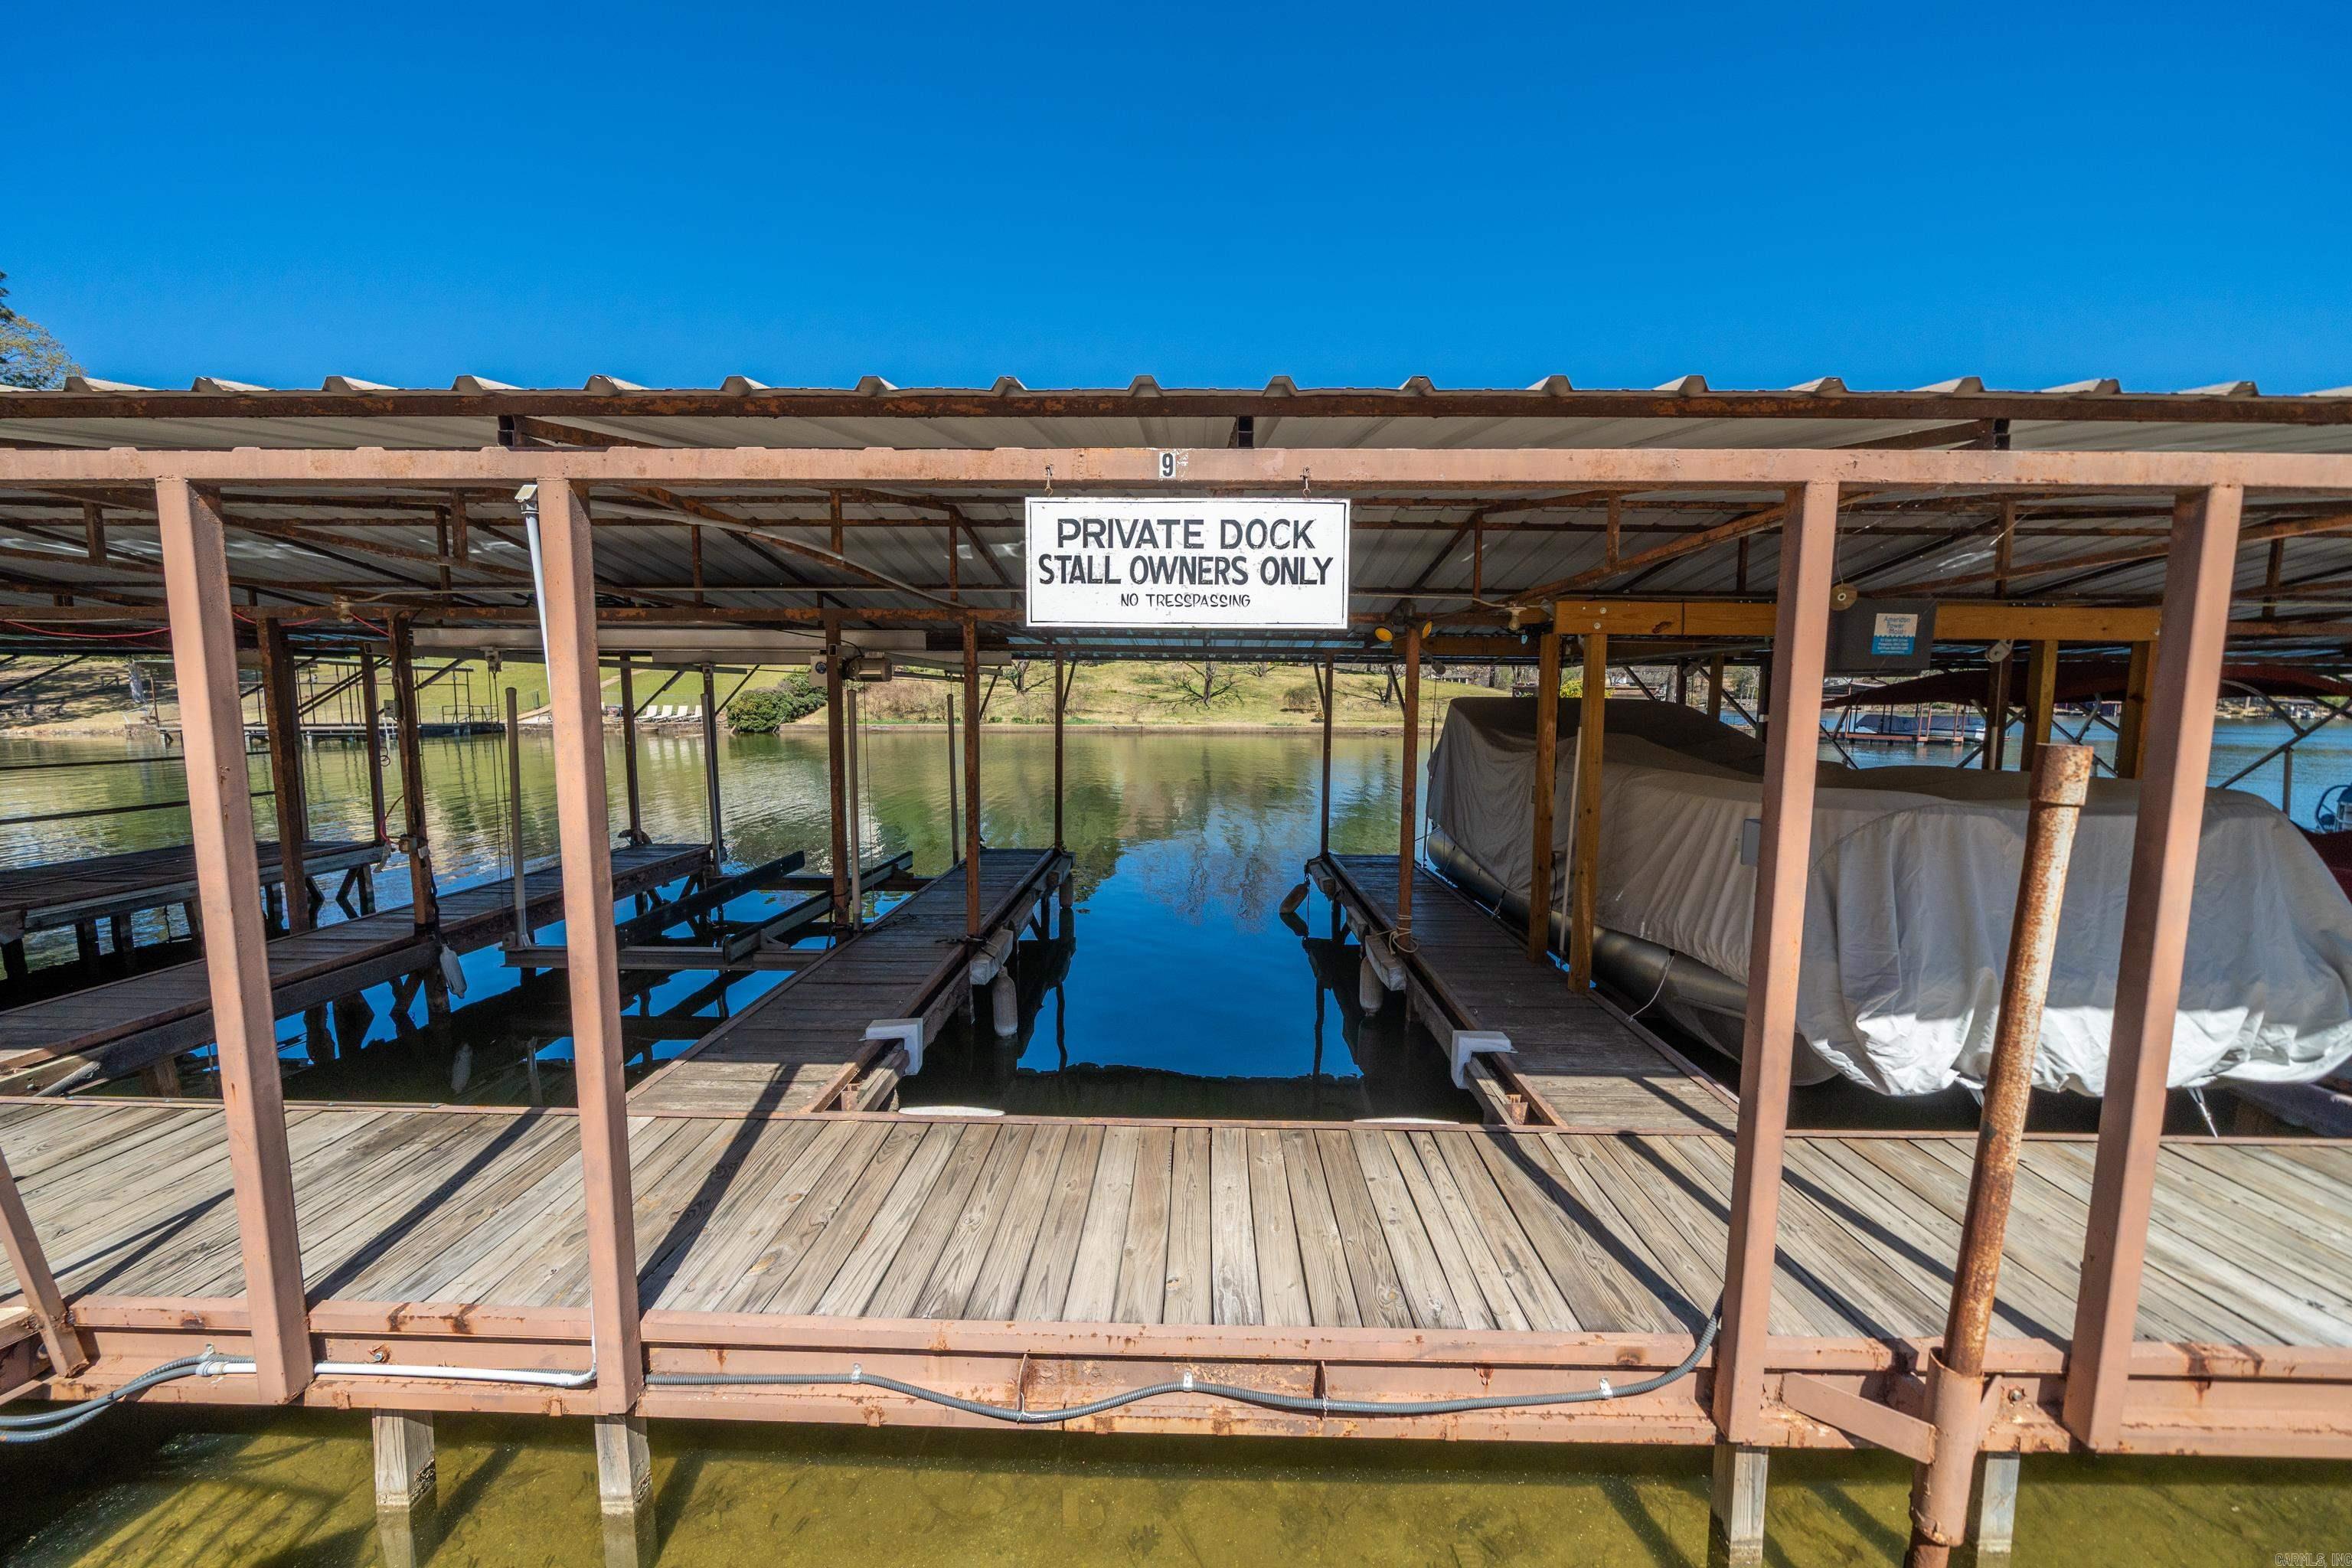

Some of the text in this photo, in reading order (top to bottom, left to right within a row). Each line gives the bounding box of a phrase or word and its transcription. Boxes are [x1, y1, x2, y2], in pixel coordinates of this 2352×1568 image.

[1161, 452, 1174, 477] 9
[1057, 518, 1317, 550] PRIVATE DOCK
[1038, 553, 1334, 586] STALL OWNERS ONLY
[1120, 593, 1251, 609] NO TRESSPASSING
